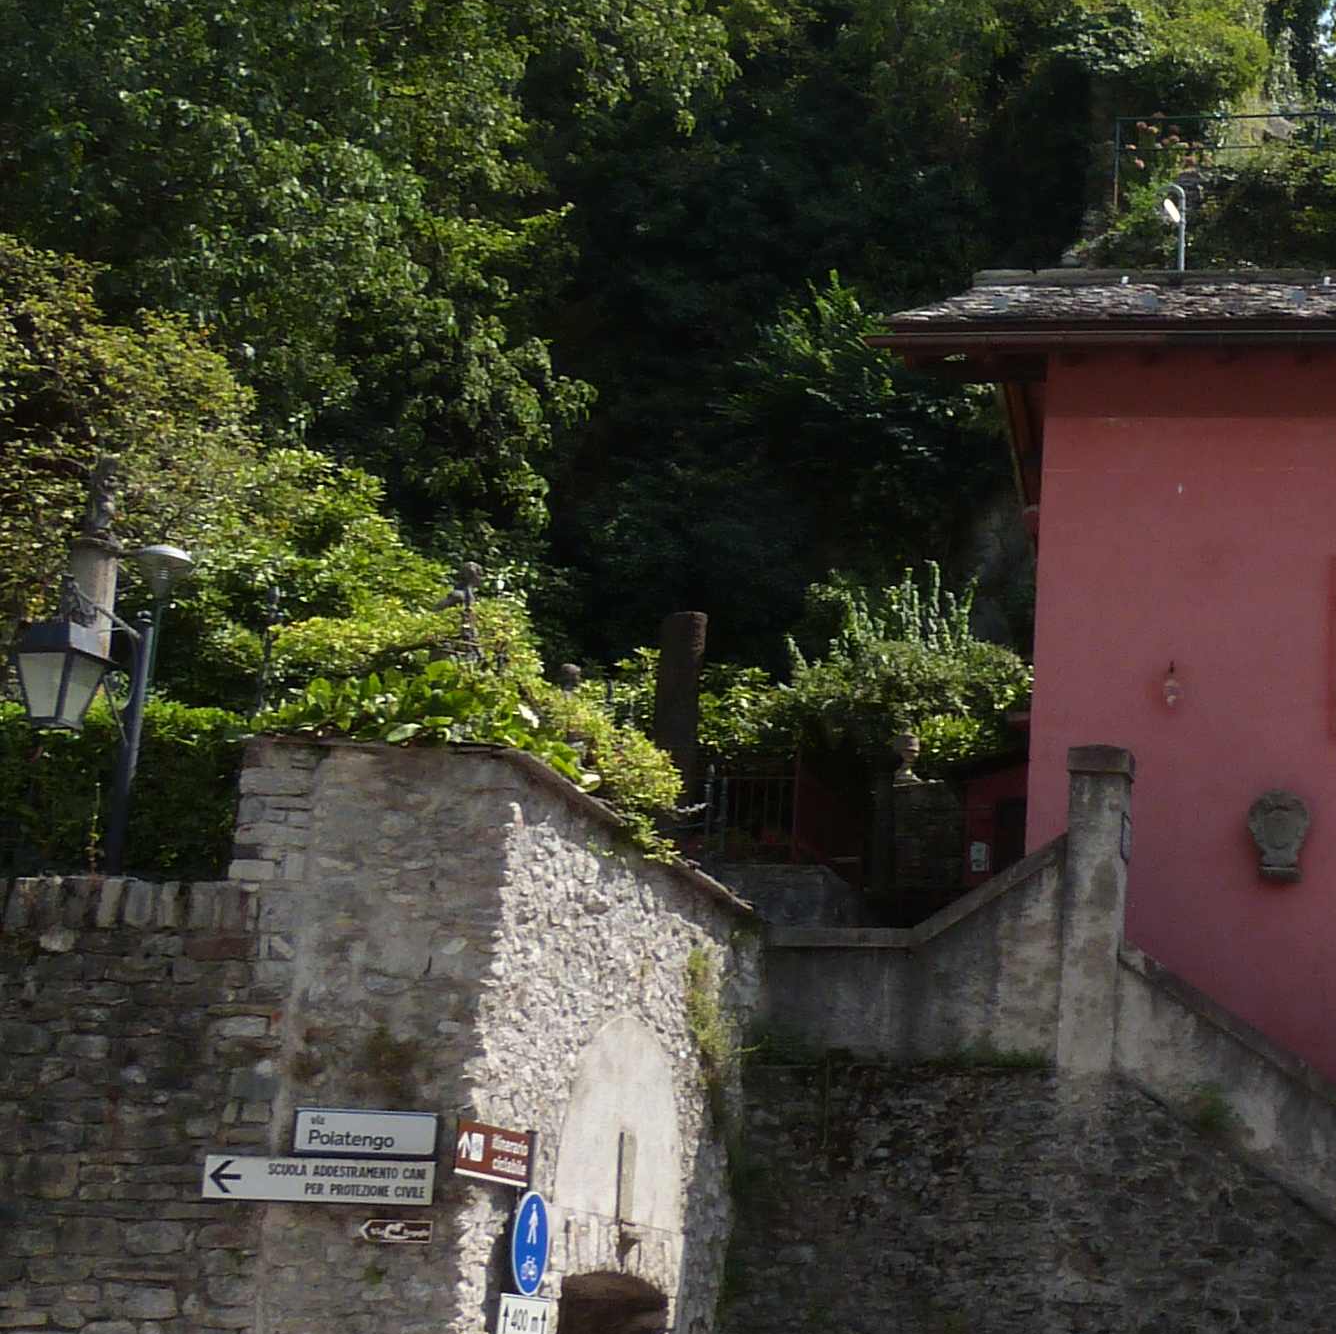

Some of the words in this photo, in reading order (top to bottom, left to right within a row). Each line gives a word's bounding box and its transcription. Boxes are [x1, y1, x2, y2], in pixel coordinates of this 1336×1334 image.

[267, 1162, 307, 1177] SCUOLA
[312, 1164, 399, 1179] ADDESTRAMENTO
[402, 1167, 426, 1180] CANI
[304, 1182, 325, 1196] PER
[330, 1183, 390, 1197] PROTEZIONE
[394, 1185, 425, 1199] CIVILE
[511, 1308, 530, 1332] 400
